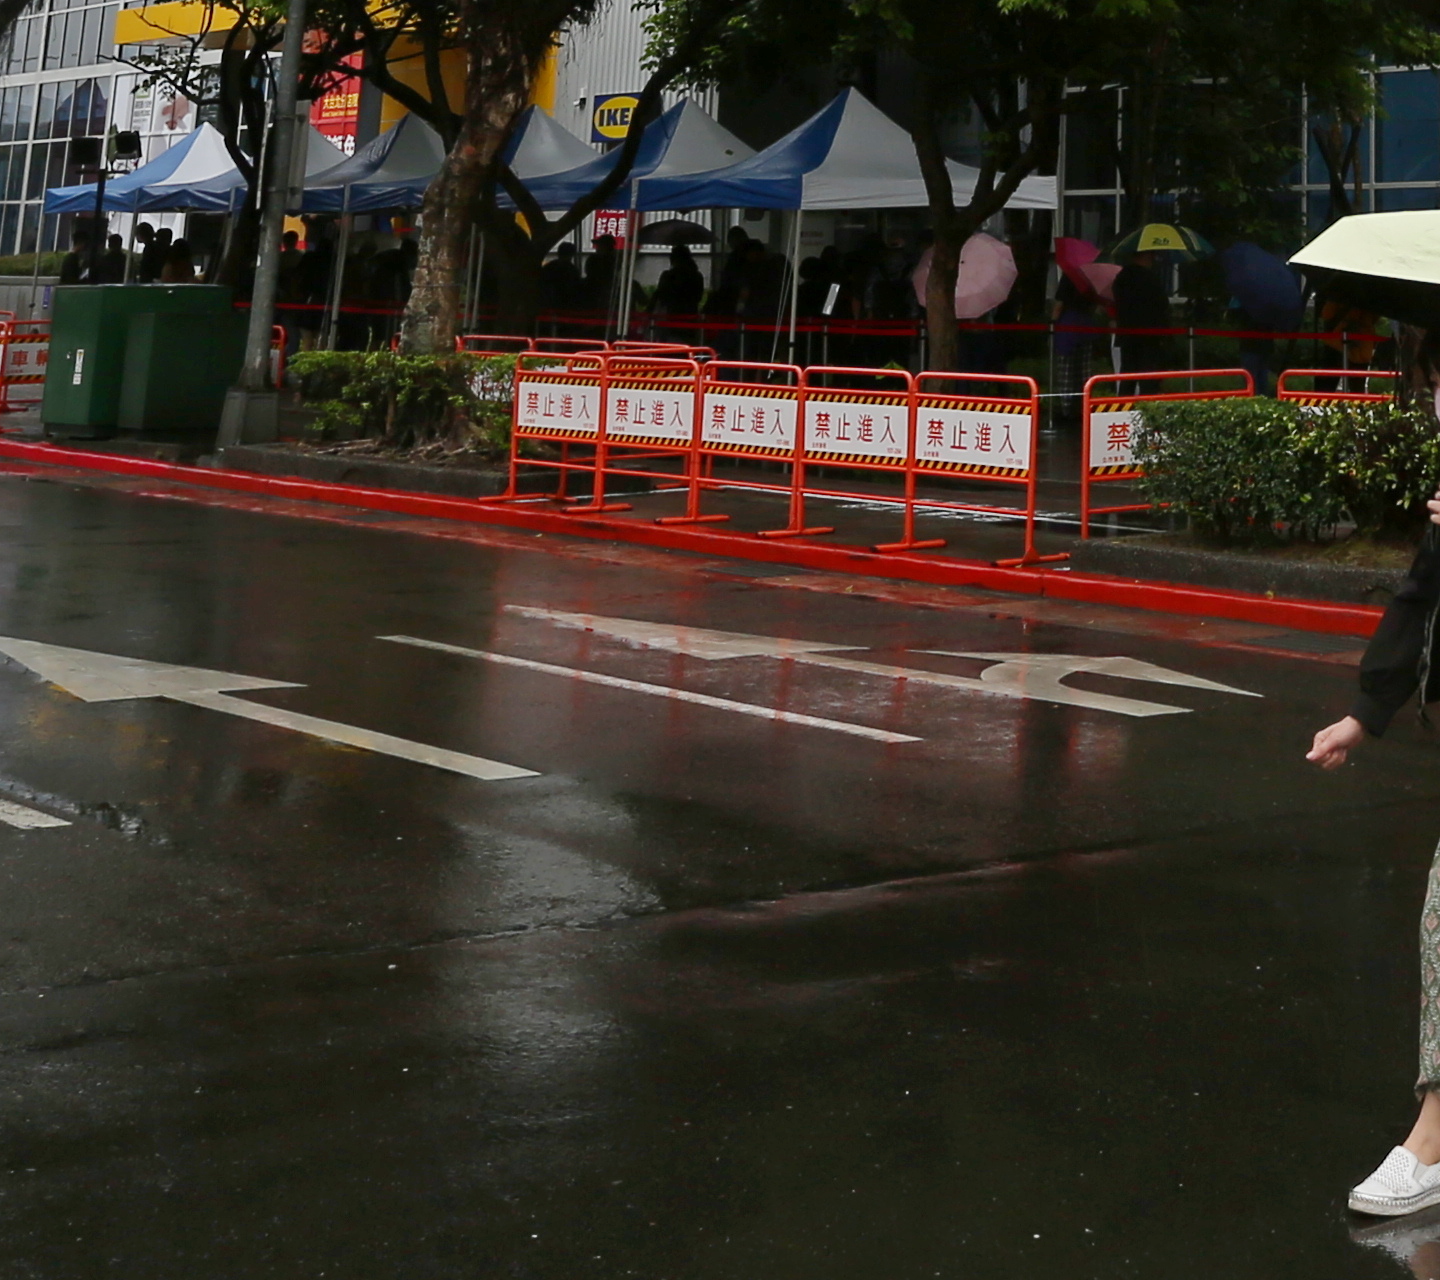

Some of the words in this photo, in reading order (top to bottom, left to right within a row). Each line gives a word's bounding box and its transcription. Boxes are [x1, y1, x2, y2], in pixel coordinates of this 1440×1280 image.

[598, 106, 631, 128] IKE
[525, 391, 591, 420] 禁止進入
[615, 397, 683, 427] 禁止進入
[711, 404, 785, 436] 禁止進入
[815, 411, 896, 444] 禁止進入
[926, 418, 1016, 454] 禁止進入
